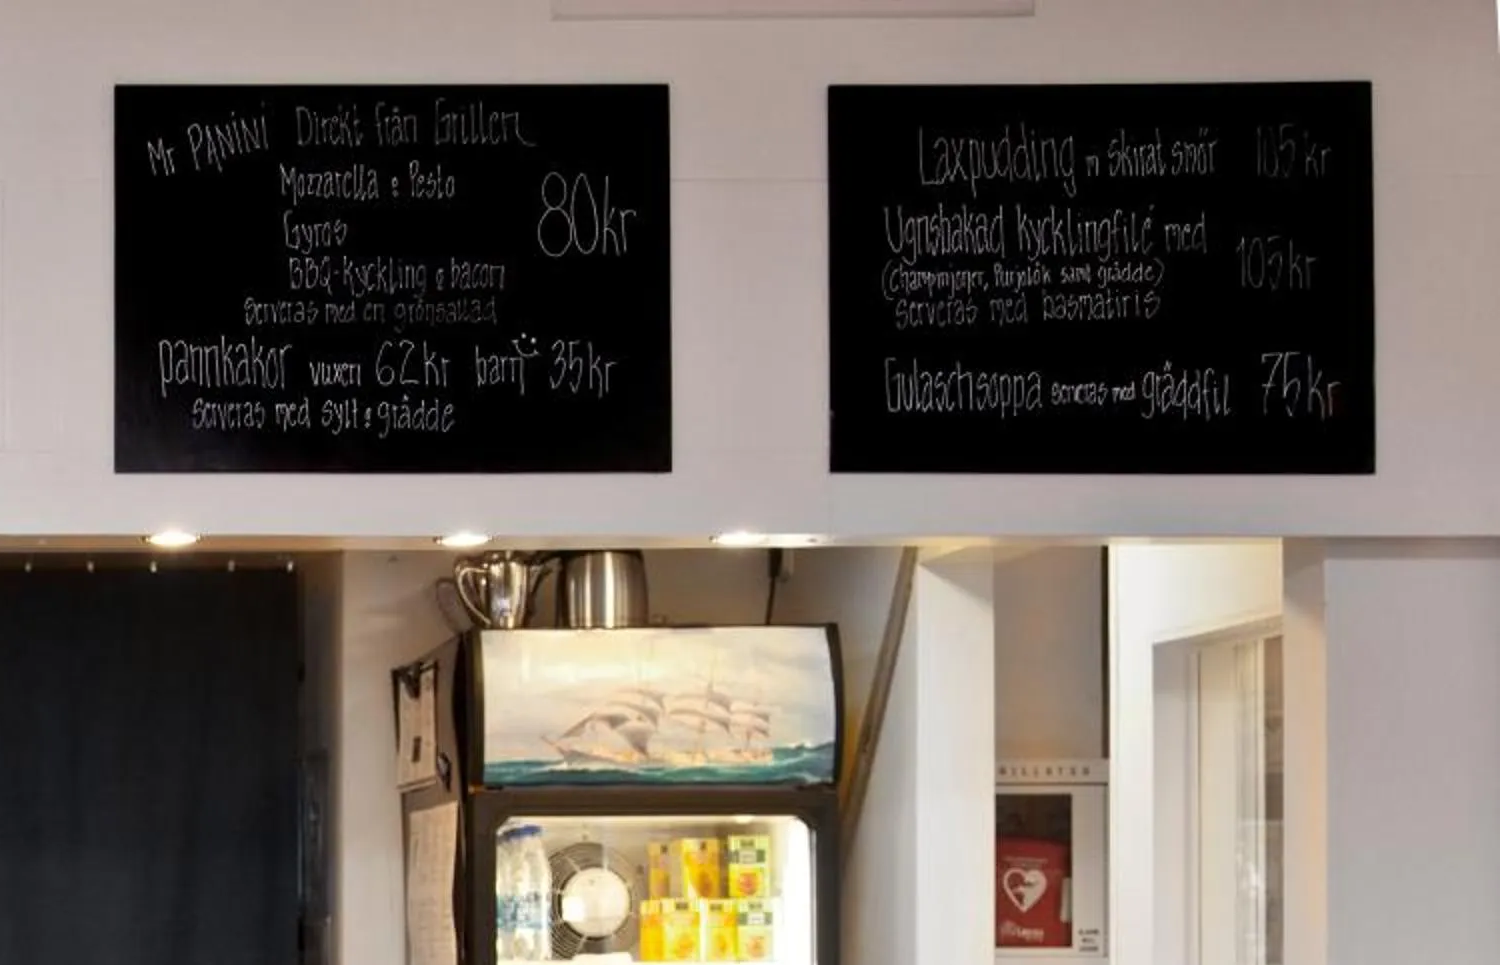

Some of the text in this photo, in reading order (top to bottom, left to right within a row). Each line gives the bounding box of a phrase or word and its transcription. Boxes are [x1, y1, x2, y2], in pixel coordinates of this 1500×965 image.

[918, 121, 1078, 198] Laxpudding
[1164, 209, 1208, 255] med
[474, 343, 527, 395] barn
[275, 397, 310, 429] med
